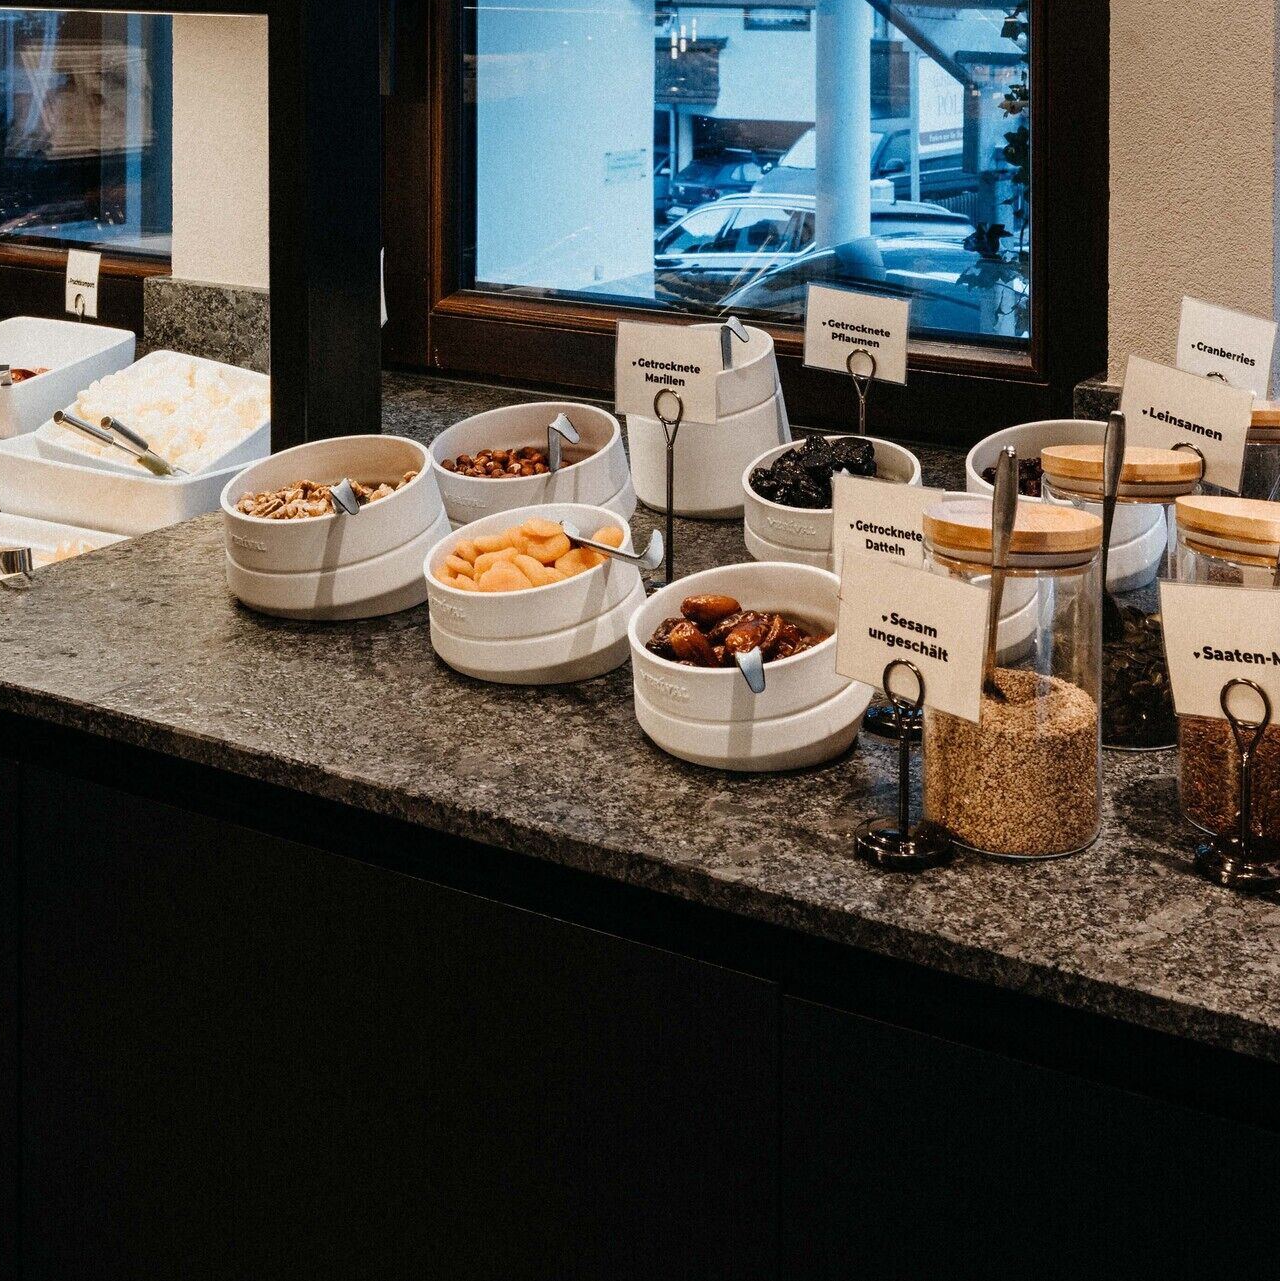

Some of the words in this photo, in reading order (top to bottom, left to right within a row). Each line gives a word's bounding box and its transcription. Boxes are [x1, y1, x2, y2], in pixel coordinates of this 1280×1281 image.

[827, 318, 891, 338] Getrocknete
[830, 331, 880, 349] Pflaumen
[1196, 341, 1256, 367] Cranberries
[637, 357, 701, 375] Getrocknete
[645, 372, 686, 387] Marillen
[1149, 406, 1223, 442] Leinsamen
[855, 519, 923, 542] Getrocknete
[865, 538, 906, 557] Datteln
[889, 612, 938, 639] Sesam
[868, 626, 949, 663] ungeschält
